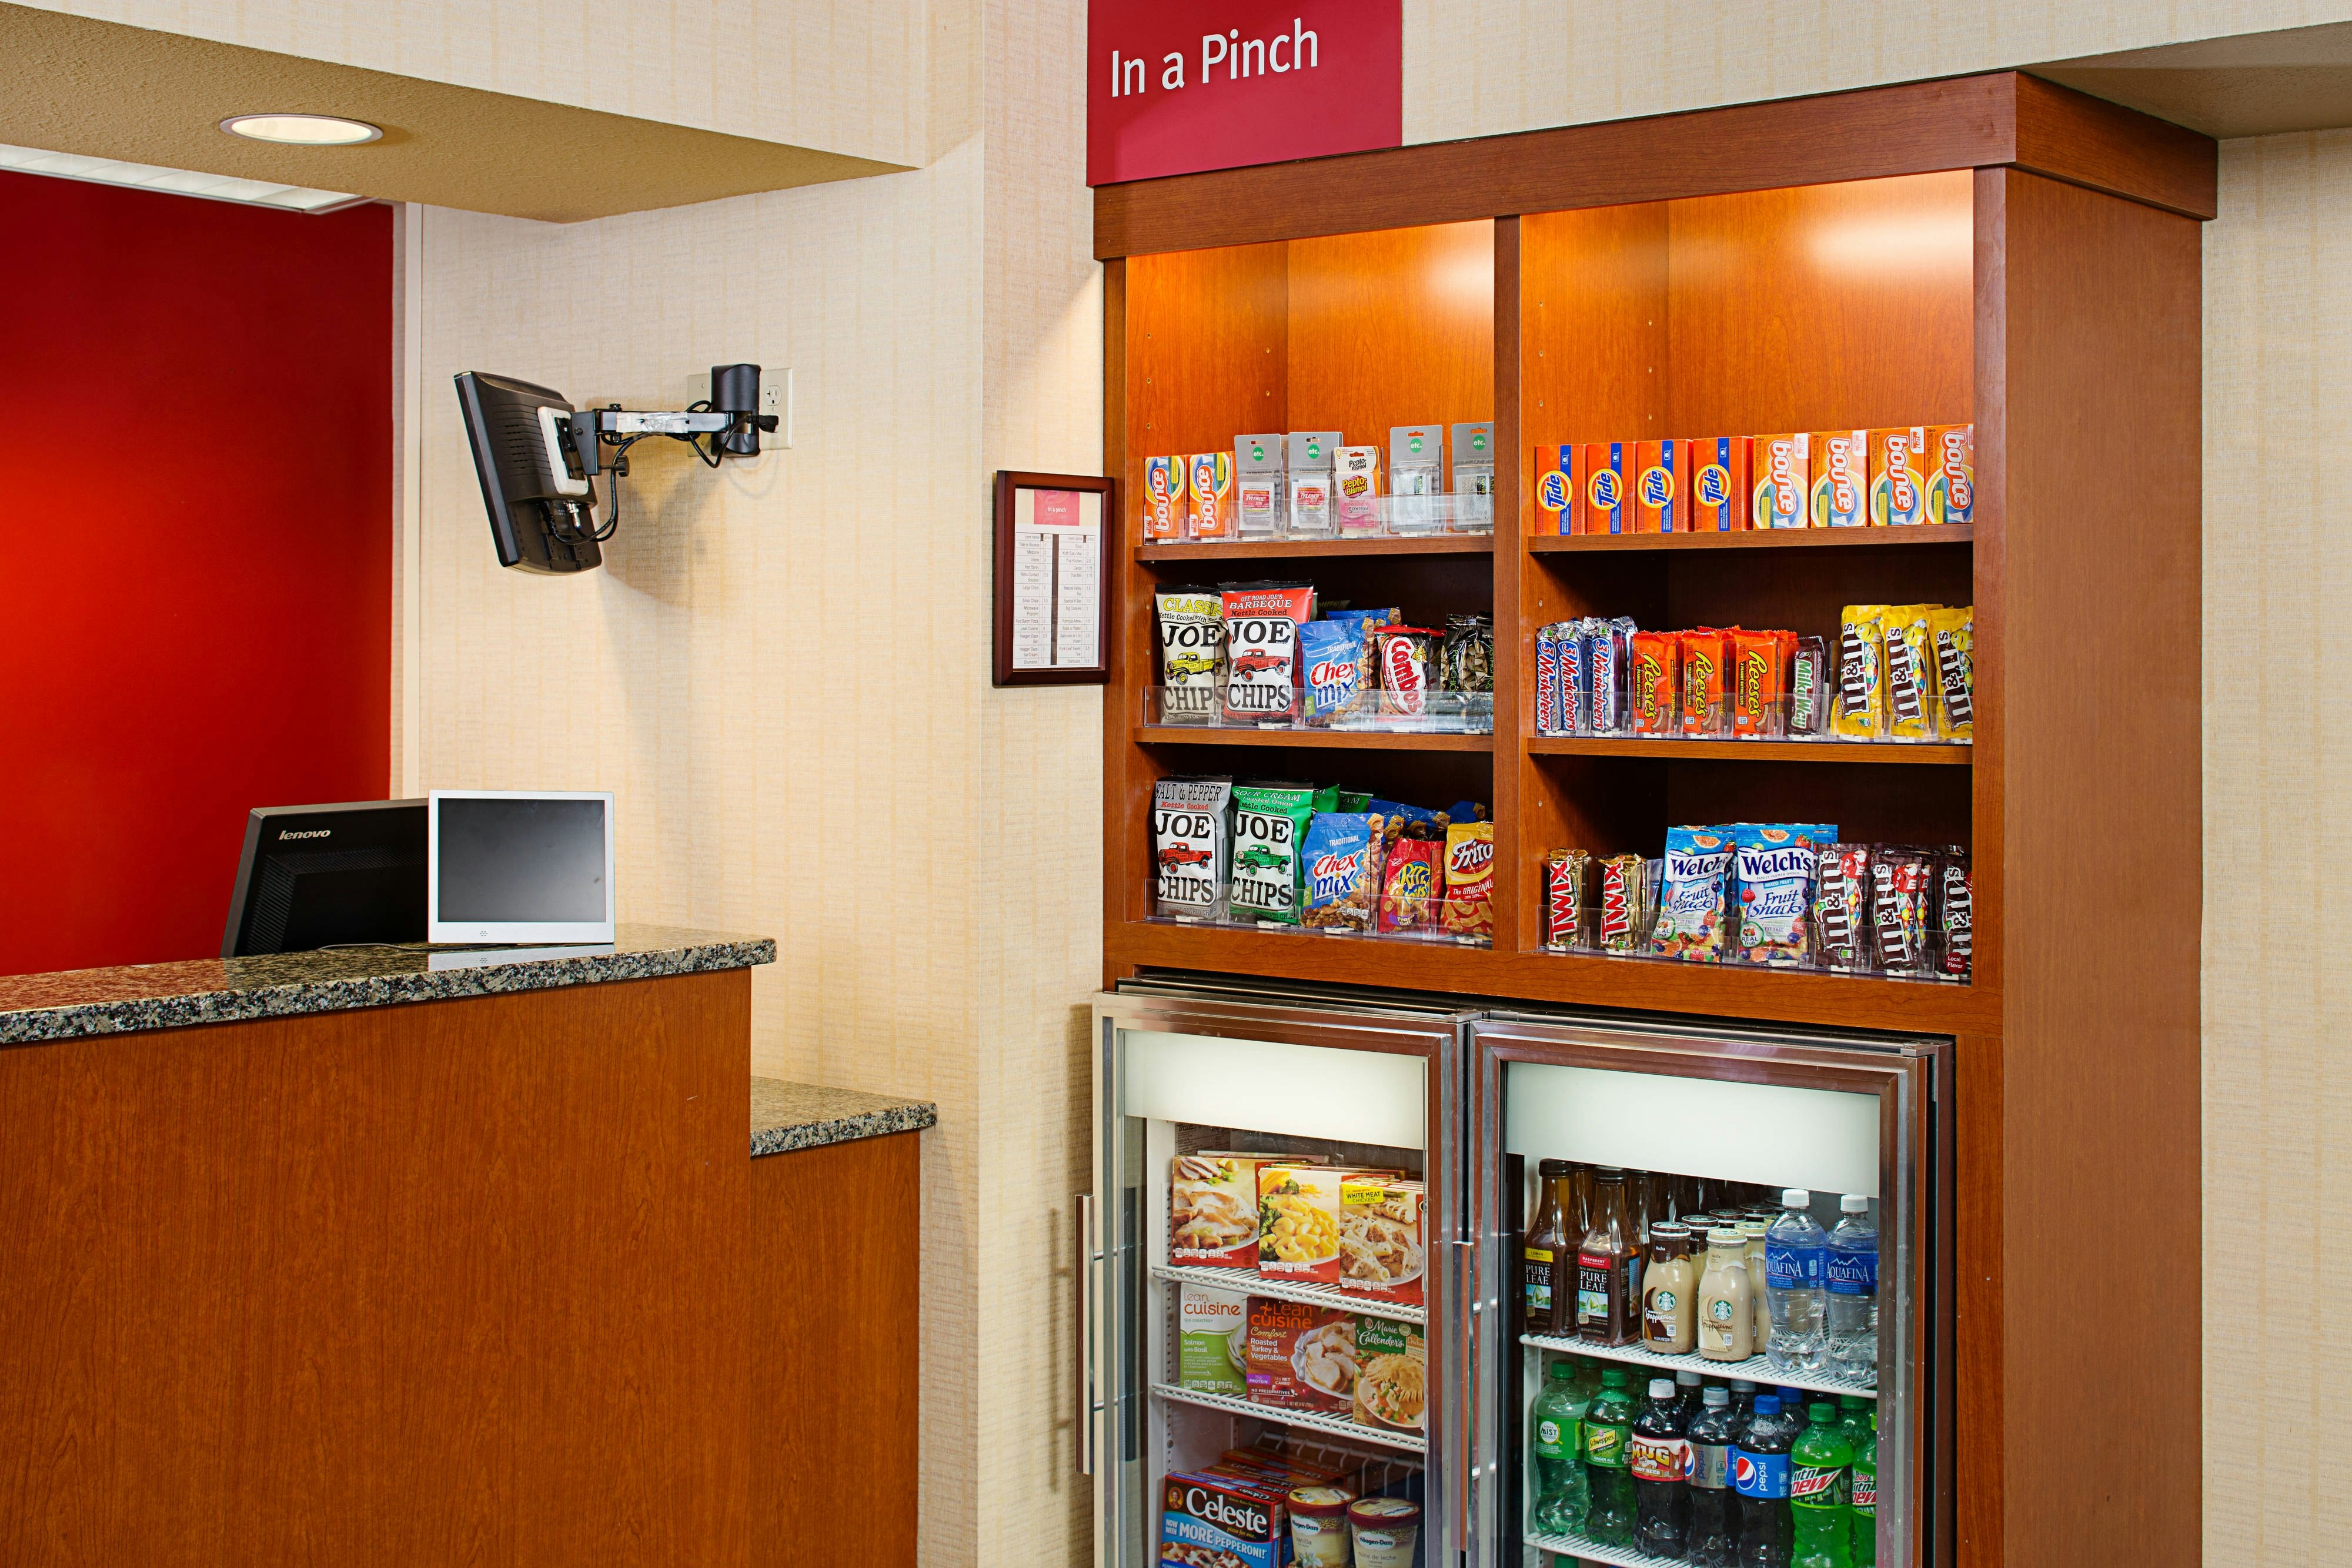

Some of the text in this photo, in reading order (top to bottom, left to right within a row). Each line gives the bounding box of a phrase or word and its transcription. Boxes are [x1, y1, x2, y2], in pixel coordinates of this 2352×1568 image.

[1112, 17, 1318, 98] In a Pinch
[1349, 459, 1366, 468] Pepto-
[1885, 436, 1912, 511] bounce
[1941, 433, 1969, 509] bounce
[1342, 477, 1367, 490] Pepto-
[1703, 467, 1724, 503] Tide
[1769, 442, 1795, 514] bounce
[1827, 439, 1853, 513] bounce
[1197, 465, 1218, 530] bounce
[1346, 482, 1368, 496] Bismol
[1546, 474, 1566, 508] Tide
[1597, 472, 1616, 506] Tide
[1646, 470, 1668, 504] Tide
[1152, 469, 1172, 532] bounce
[1229, 600, 1292, 609] BARBEQUE
[1162, 624, 1222, 647] JOE
[1232, 620, 1291, 644] JOE
[1327, 641, 1358, 654] TRADITIONAL
[1540, 643, 1554, 656] 3
[1562, 644, 1576, 657] 3
[1595, 641, 1608, 653] 3
[1310, 660, 1356, 686] Chex
[1391, 640, 1422, 713] Combos
[1695, 650, 1714, 717] Reese's
[1317, 680, 1355, 708] mix
[1538, 654, 1554, 730] Musketeers
[1561, 655, 1577, 731] Musketeers
[1593, 653, 1608, 731] Musketeers
[1643, 654, 1662, 720] Reese's
[1748, 650, 1768, 718] Reese's
[1792, 660, 1813, 728] Milky Way
[1164, 685, 1227, 711] CHIPS
[1228, 684, 1291, 709] CHIPS
[1156, 783, 1222, 802] SALT & PEPPER
[1263, 791, 1301, 802] CREAM
[1260, 804, 1288, 814] Cooked
[279, 828, 331, 841] lenovo
[1156, 813, 1211, 839] JOE
[1235, 814, 1289, 844] JOE
[1329, 834, 1360, 847] TRADITIONAL
[1313, 850, 1359, 879] Chex
[1740, 851, 1812, 876] Welch's
[1315, 870, 1354, 898] mix
[1401, 863, 1431, 890] RITZ
[1463, 878, 1494, 895] ORIGINAL
[1157, 875, 1214, 903] CHIPS
[1232, 876, 1293, 907] CHIPS
[1679, 885, 1710, 901] Fruit
[1765, 889, 1800, 906] Fruit
[1549, 861, 1577, 941] TWIX
[1601, 862, 1629, 944] TWIX
[1668, 897, 1713, 914] Snacks
[1750, 901, 1805, 918] Snacks
[1525, 1265, 1551, 1276] PURE
[1579, 1271, 1608, 1283] PURE
[1766, 1259, 1803, 1278] AQUAFINA
[1826, 1262, 1870, 1282] AQUAFINA
[1526, 1273, 1549, 1286] LEAF
[1579, 1279, 1606, 1293] LEAF
[1184, 1290, 1210, 1302] lean
[1184, 1302, 1242, 1316] cuisine
[1273, 1303, 1312, 1318] Lean
[1645, 1307, 1676, 1323] frappuccino
[1250, 1326, 1287, 1339] Comfort
[1368, 1320, 1398, 1337] Marie
[1701, 1316, 1733, 1332] frappuccino
[1251, 1338, 1278, 1346] Roasted
[1251, 1345, 1272, 1353] Turkey
[1357, 1329, 1405, 1348] Callender's
[1251, 1352, 1288, 1361] Vegetables
[1541, 1427, 1557, 1436] MIST
[1589, 1433, 1614, 1449] Schweppes
[1632, 1443, 1670, 1466] MUG
[1697, 1449, 1705, 1479] pepsi
[1758, 1462, 1768, 1492] pepsi
[1186, 1487, 1267, 1534] Celeste
[1165, 1519, 1178, 1527] NOW
[1165, 1526, 1177, 1536] WITH
[1179, 1522, 1214, 1544] MORE
[1359, 1536, 1393, 1547] Häagen-Dazs
